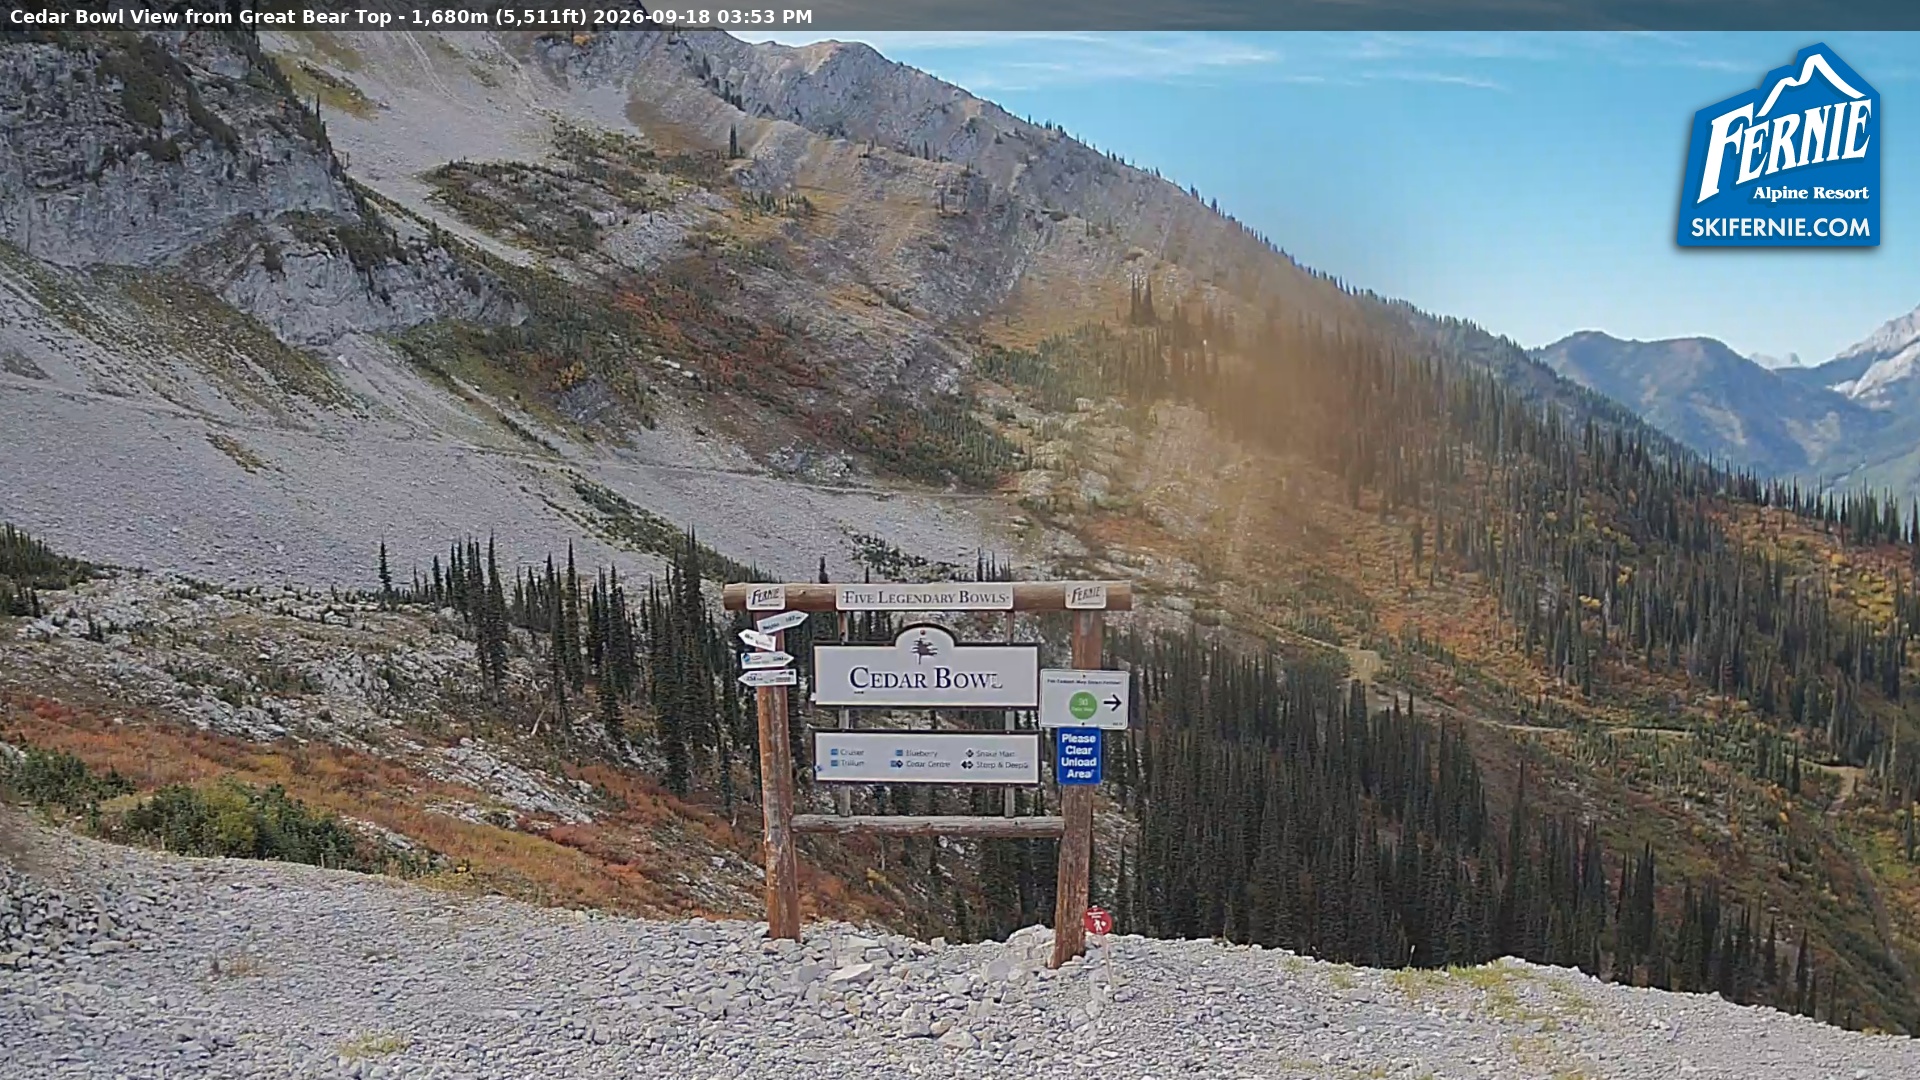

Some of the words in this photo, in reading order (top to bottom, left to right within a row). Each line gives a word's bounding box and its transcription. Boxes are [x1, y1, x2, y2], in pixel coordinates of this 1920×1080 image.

[844, 590, 874, 604] FIVE
[878, 591, 956, 604] LEGENDARY
[959, 590, 1006, 604] BOWLS
[850, 666, 928, 689] CEDAR
[1061, 733, 1097, 743] Please
[1065, 745, 1093, 755] Clear
[1061, 757, 1097, 767] Unload
